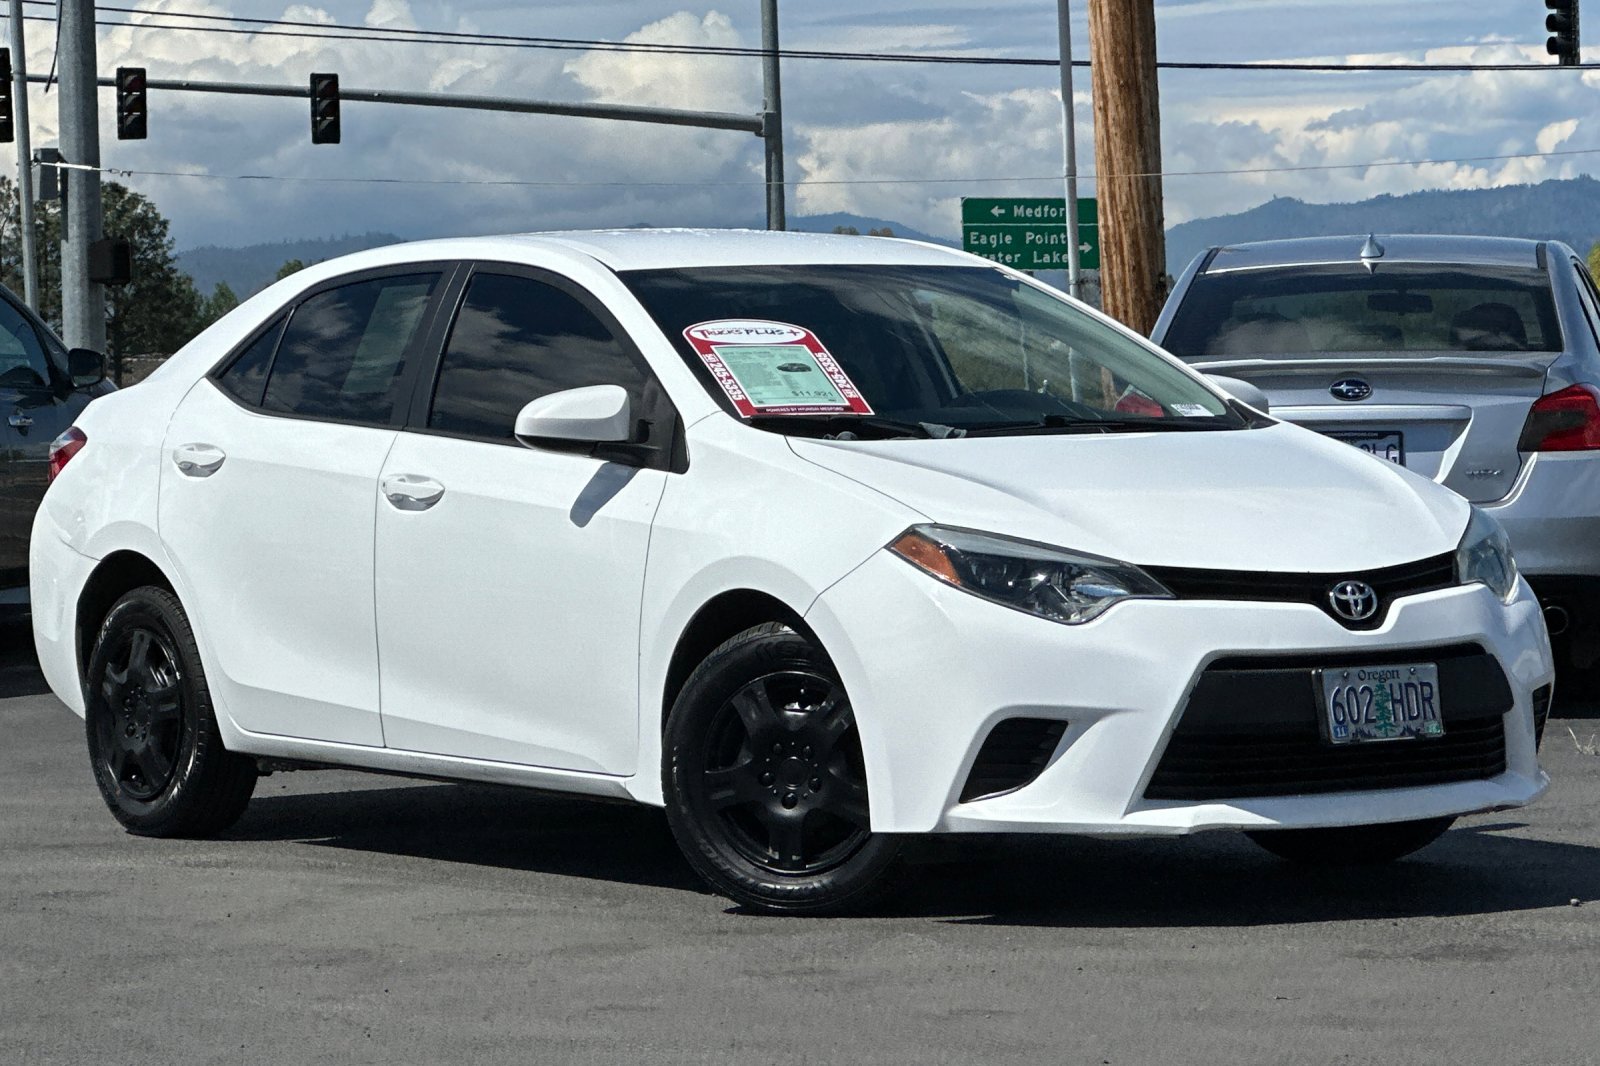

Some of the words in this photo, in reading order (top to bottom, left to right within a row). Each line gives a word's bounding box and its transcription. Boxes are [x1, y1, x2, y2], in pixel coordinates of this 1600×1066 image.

[1013, 205, 1066, 218] Medfor
[970, 232, 1013, 247] Eagle
[1025, 232, 1068, 245] Point
[1033, 250, 1069, 263] Lake
[1357, 669, 1400, 682] Oregon
[1330, 684, 1377, 725] 602
[1389, 681, 1436, 722] HDR
